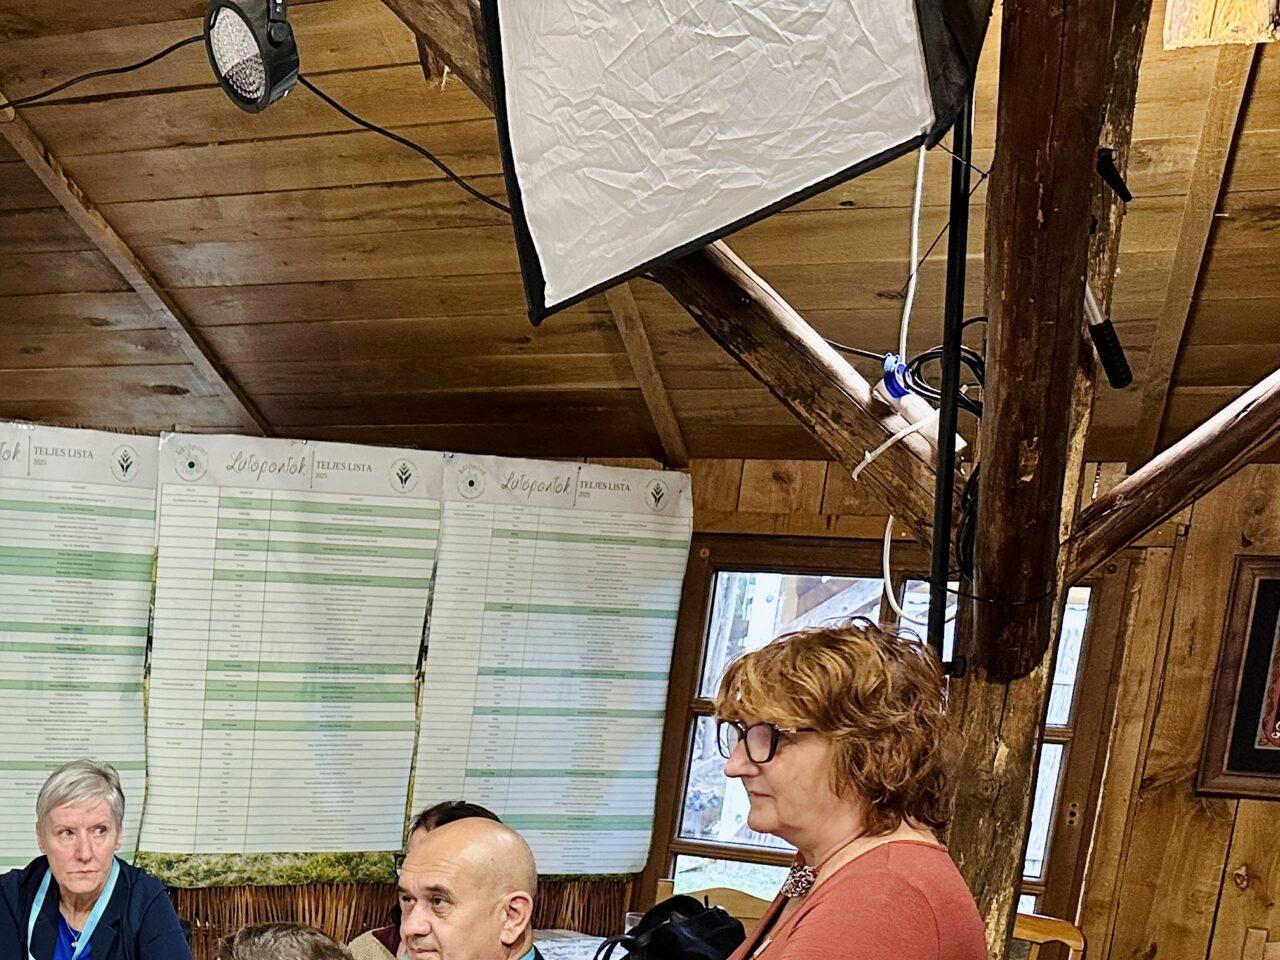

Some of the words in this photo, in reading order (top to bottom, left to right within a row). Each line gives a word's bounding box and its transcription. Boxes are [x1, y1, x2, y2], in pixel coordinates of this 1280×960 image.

[33, 446, 66, 458] TELJES
[68, 448, 94, 460] LISTA
[316, 460, 346, 471] TELJES
[348, 462, 373, 473] LISTA
[579, 480, 608, 490] TELJES
[609, 482, 631, 492] LISTA
